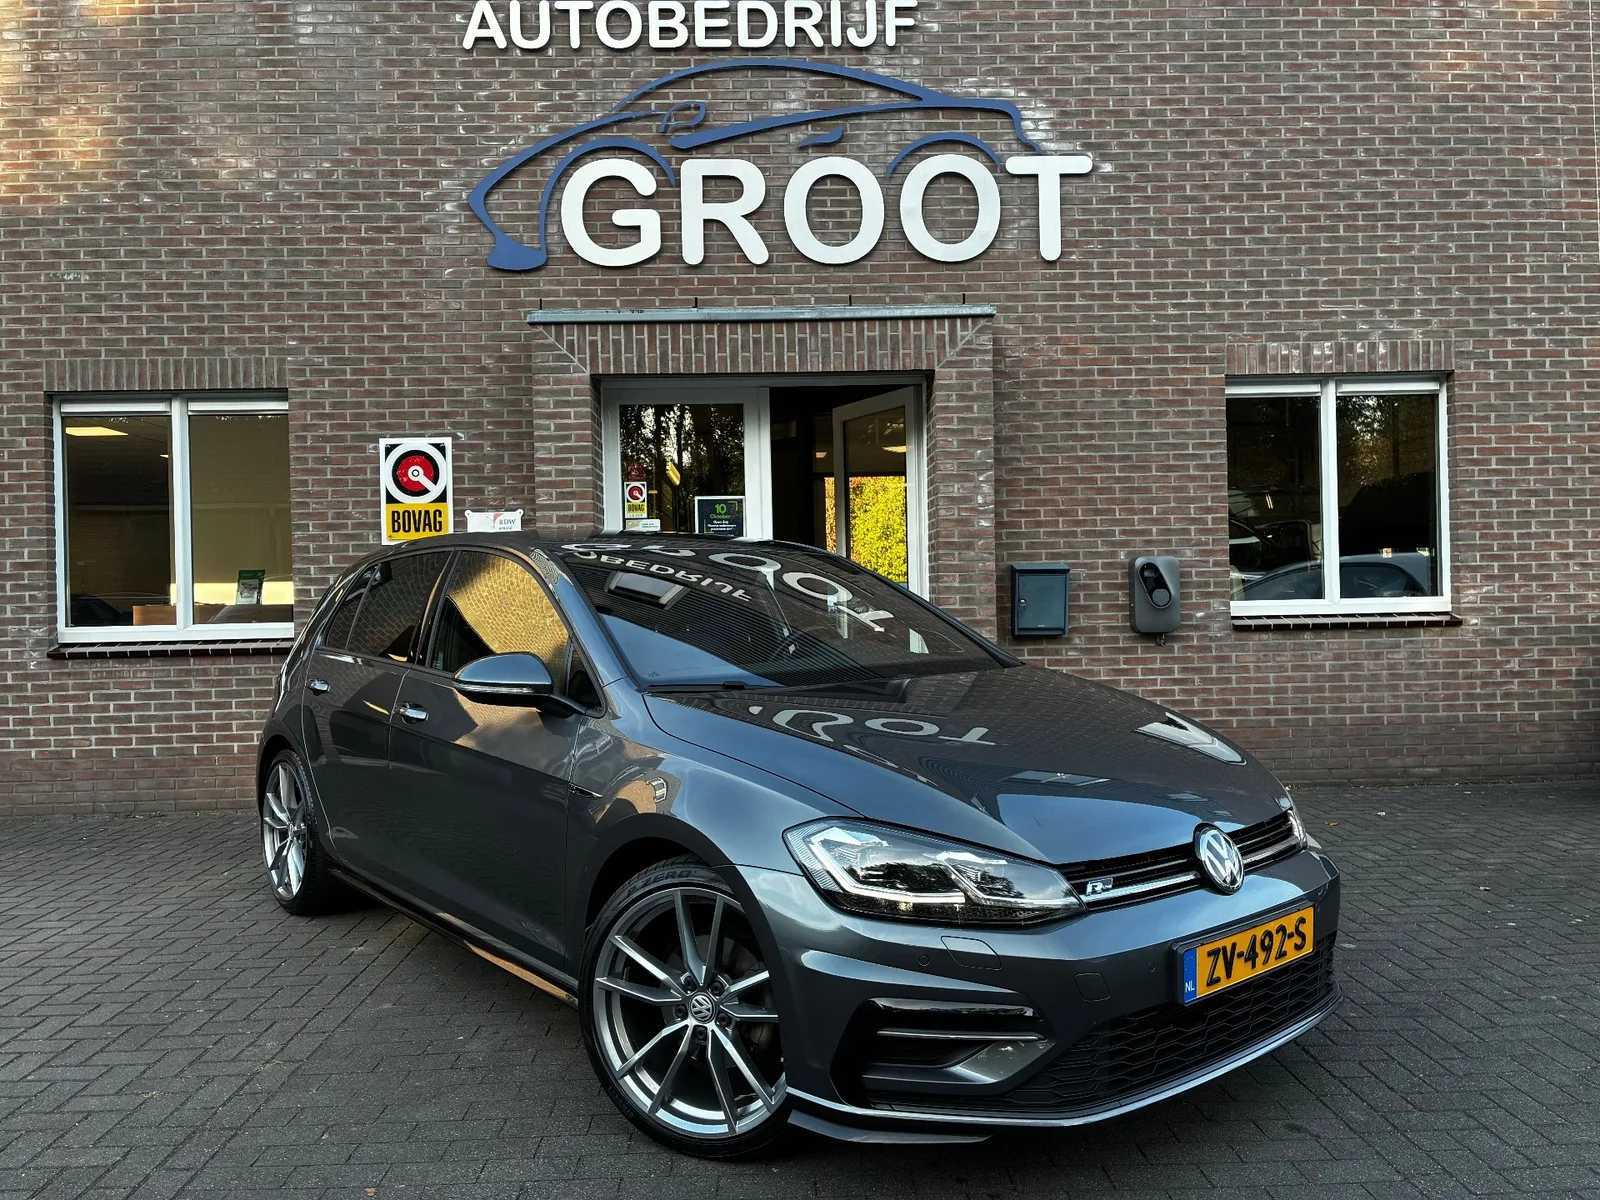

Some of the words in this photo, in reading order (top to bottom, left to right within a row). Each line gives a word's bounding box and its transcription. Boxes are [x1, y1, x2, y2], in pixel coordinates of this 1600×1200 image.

[462, 0, 917, 49] AUTOBEDRIJF
[560, 154, 1093, 267] GROOT
[391, 508, 443, 533] BOVAG
[627, 504, 645, 512] BOVAG
[714, 503, 727, 514] 10
[1206, 917, 1307, 987] ZV-492-S
[1184, 978, 1196, 994] NL
